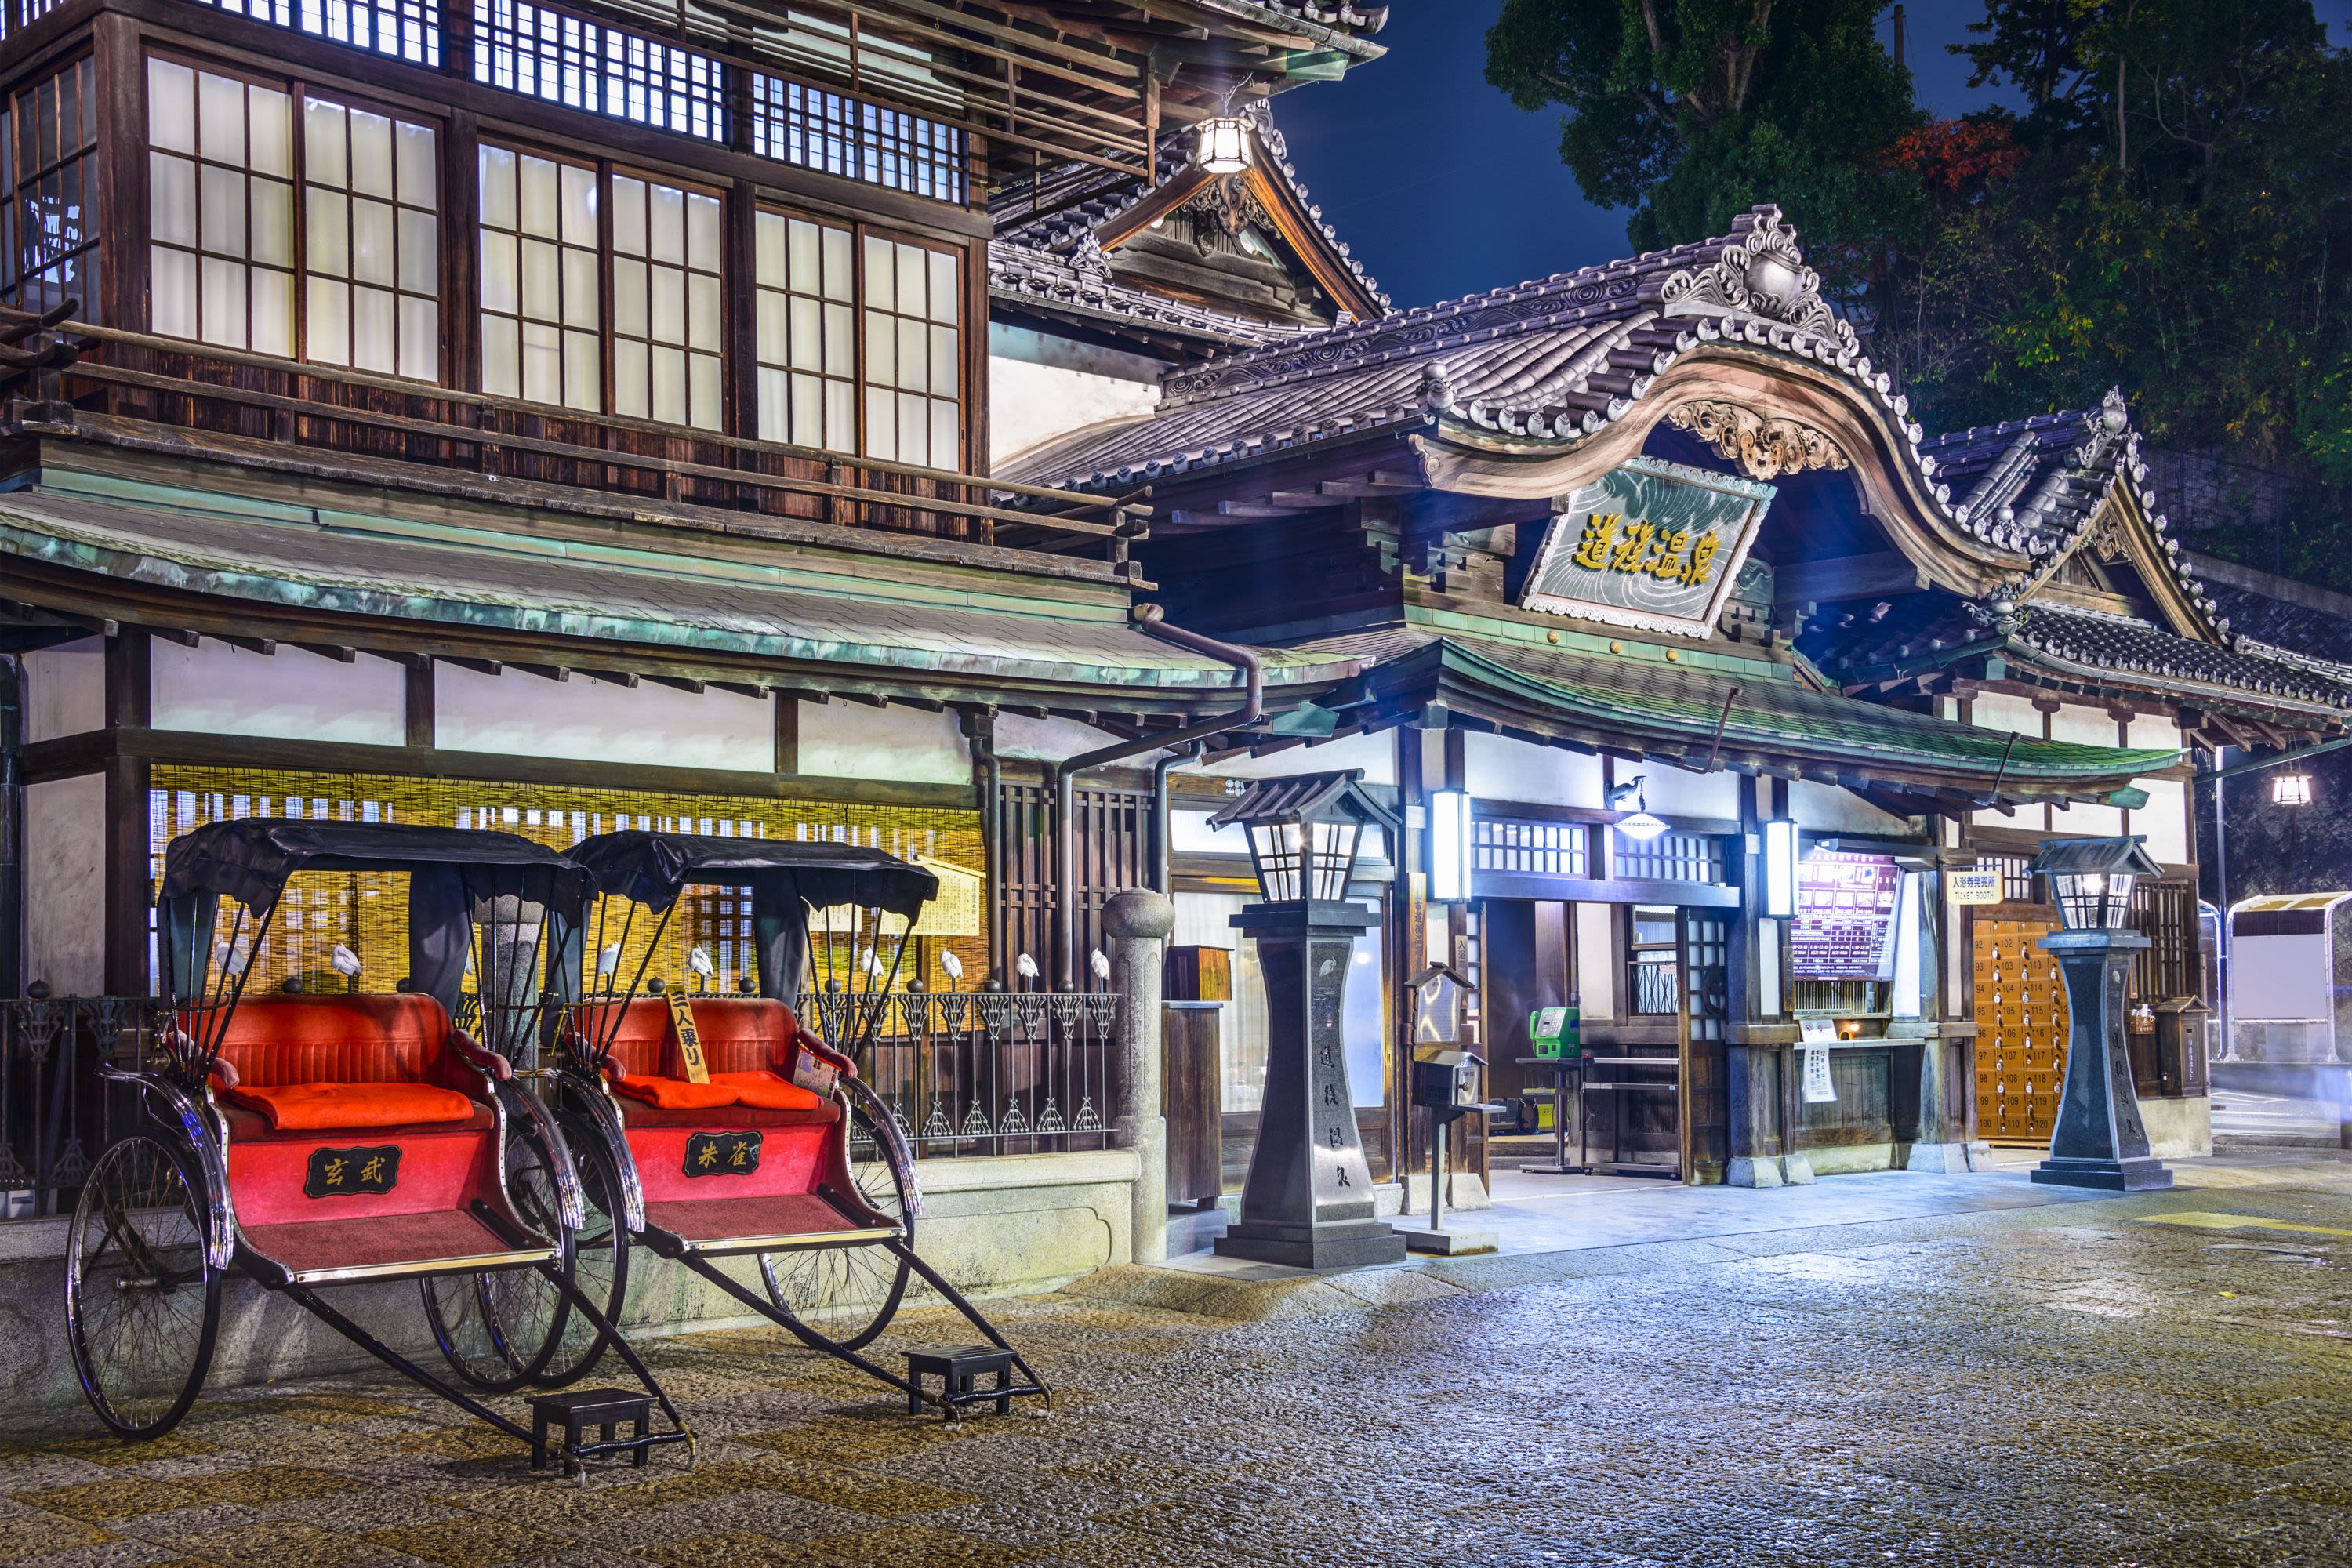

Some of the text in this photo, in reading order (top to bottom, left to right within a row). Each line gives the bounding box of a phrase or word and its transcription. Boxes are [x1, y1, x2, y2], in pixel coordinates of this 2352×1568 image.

[1572, 511, 1722, 586] 道後温泉
[1953, 876, 1995, 888] 入浴券発売所
[1955, 891, 1994, 900] TICKET BOOTH
[1975, 940, 1983, 949] 92
[1975, 963, 1984, 971] 93
[2002, 961, 2013, 970] 103
[2029, 960, 2042, 969] 113
[1976, 985, 1984, 993] 94
[2002, 984, 2014, 993] 104
[2030, 983, 2042, 992] 114
[1976, 1007, 1985, 1016] 95
[2003, 1006, 2015, 1015] 105
[2031, 1005, 2044, 1014] 115
[1978, 1029, 1986, 1038] 96
[2004, 1029, 2016, 1038] 106
[2032, 1029, 2045, 1037] 116
[1978, 1051, 1987, 1061] 97
[2005, 1051, 2016, 1060] 107
[2033, 1051, 2045, 1060] 117
[1980, 1073, 1988, 1083] 98
[2005, 1073, 2018, 1083] 108
[2034, 1073, 2046, 1083] 118
[1980, 1096, 1989, 1105] 99
[2007, 1096, 2019, 1105] 109
[2035, 1096, 2047, 1105] 119
[1319, 1046, 1351, 1187] 道後温泉
[1980, 1119, 1991, 1128] 100
[2008, 1119, 2020, 1128] 110
[2036, 1120, 2048, 1129] 120
[698, 1141, 749, 1168] 朱雀
[324, 1156, 386, 1186] 玄武
